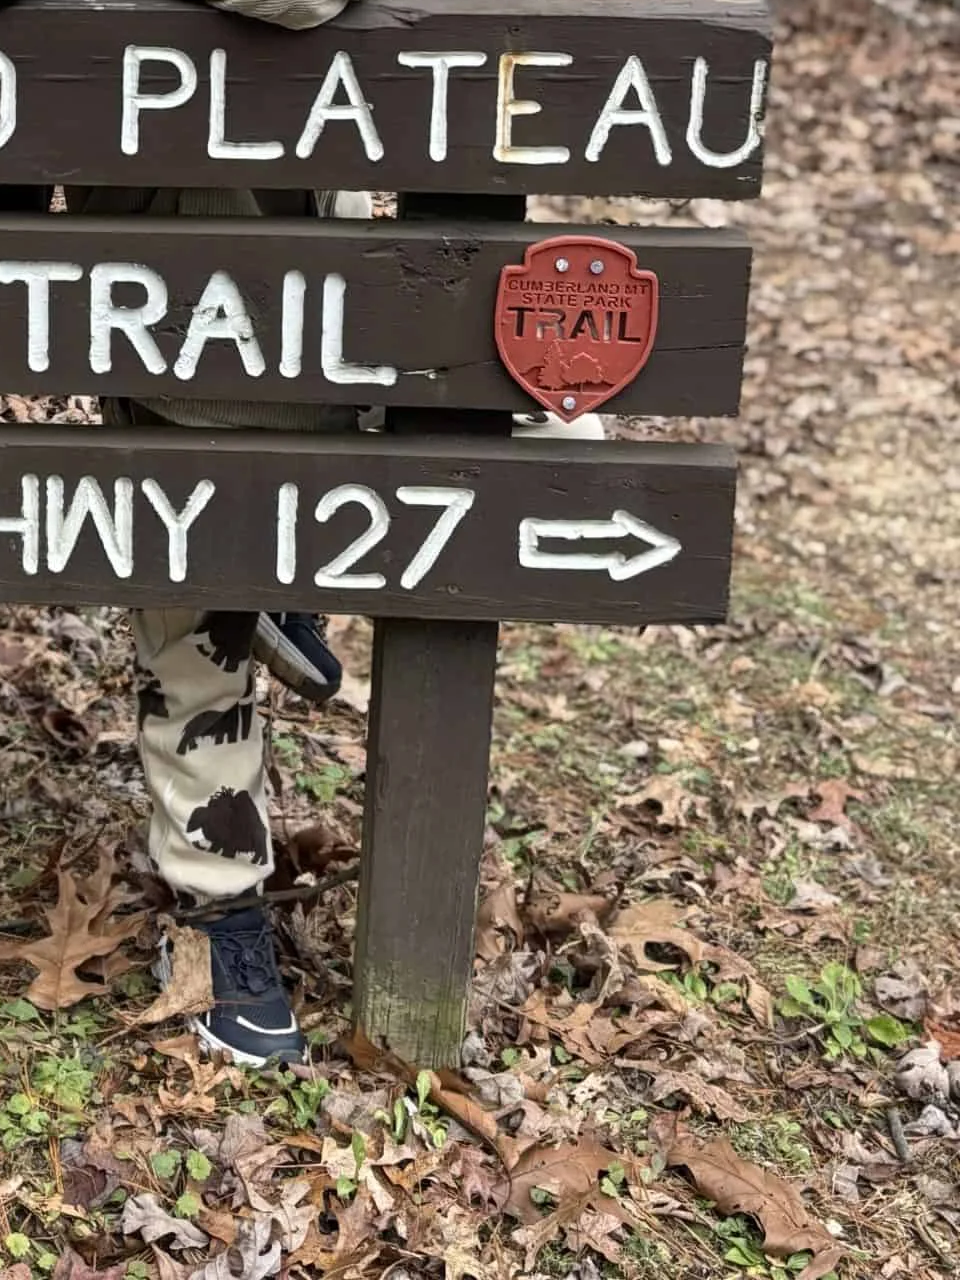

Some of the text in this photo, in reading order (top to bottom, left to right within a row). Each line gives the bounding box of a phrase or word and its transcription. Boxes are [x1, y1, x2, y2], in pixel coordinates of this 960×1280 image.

[120, 44, 768, 169] PLATEAU
[508, 279, 649, 295] CUMBERLAND MT
[522, 292, 633, 309] STATE PARK
[507, 306, 642, 343] TRAIL
[275, 482, 476, 591] 127
